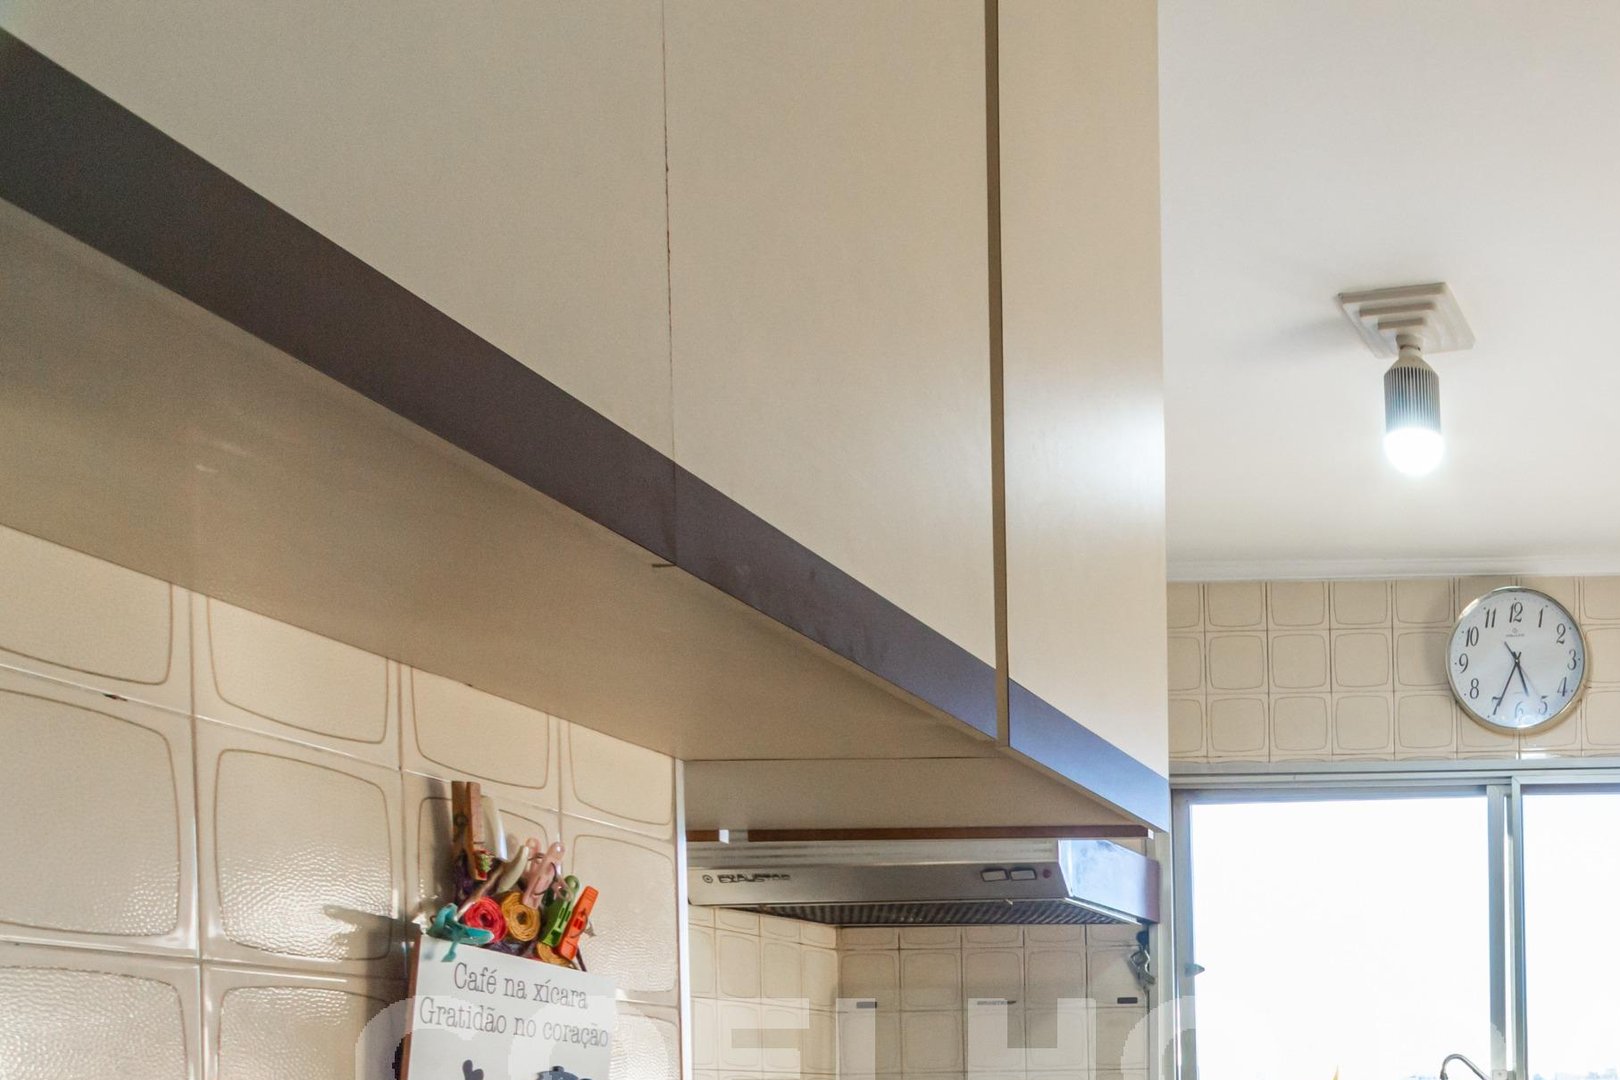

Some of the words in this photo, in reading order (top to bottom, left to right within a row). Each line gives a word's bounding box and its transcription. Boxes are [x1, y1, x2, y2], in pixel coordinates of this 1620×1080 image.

[1485, 608, 1496, 628] 11
[1509, 602, 1523, 623] 12
[1538, 608, 1544, 628] 1
[1465, 626, 1479, 647] 10
[1556, 623, 1566, 644] 2
[1458, 653, 1469, 673] 9
[1567, 649, 1577, 670] 3
[1469, 678, 1479, 699] 8
[1557, 677, 1567, 697] 4
[1491, 696, 1502, 715] 7
[1539, 695, 1548, 715] 5
[453, 962, 497, 994] Café
[504, 976, 527, 1000] na
[533, 978, 589, 1009] xícara
[419, 996, 507, 1034] Gratidão
[513, 1016, 537, 1038] no
[542, 1021, 609, 1049] coração
